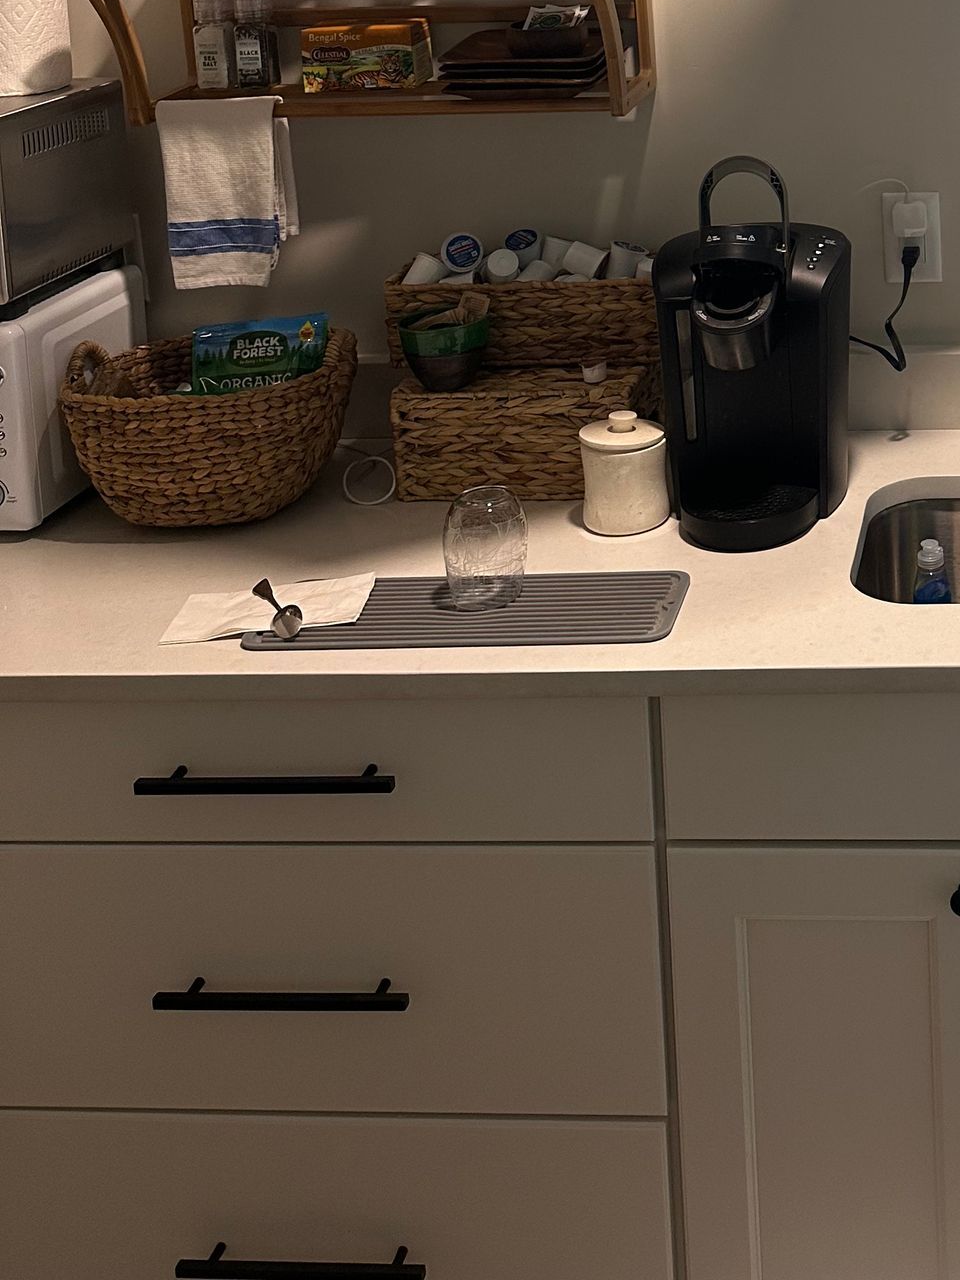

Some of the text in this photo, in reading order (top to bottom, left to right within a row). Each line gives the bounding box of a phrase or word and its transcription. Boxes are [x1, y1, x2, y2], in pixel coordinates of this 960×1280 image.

[308, 32, 361, 44] Bengal Spice
[312, 50, 349, 59] CELESTIAL
[237, 336, 280, 350] BLACK
[233, 346, 284, 359] FOREST
[220, 372, 292, 389] ORGANIC
